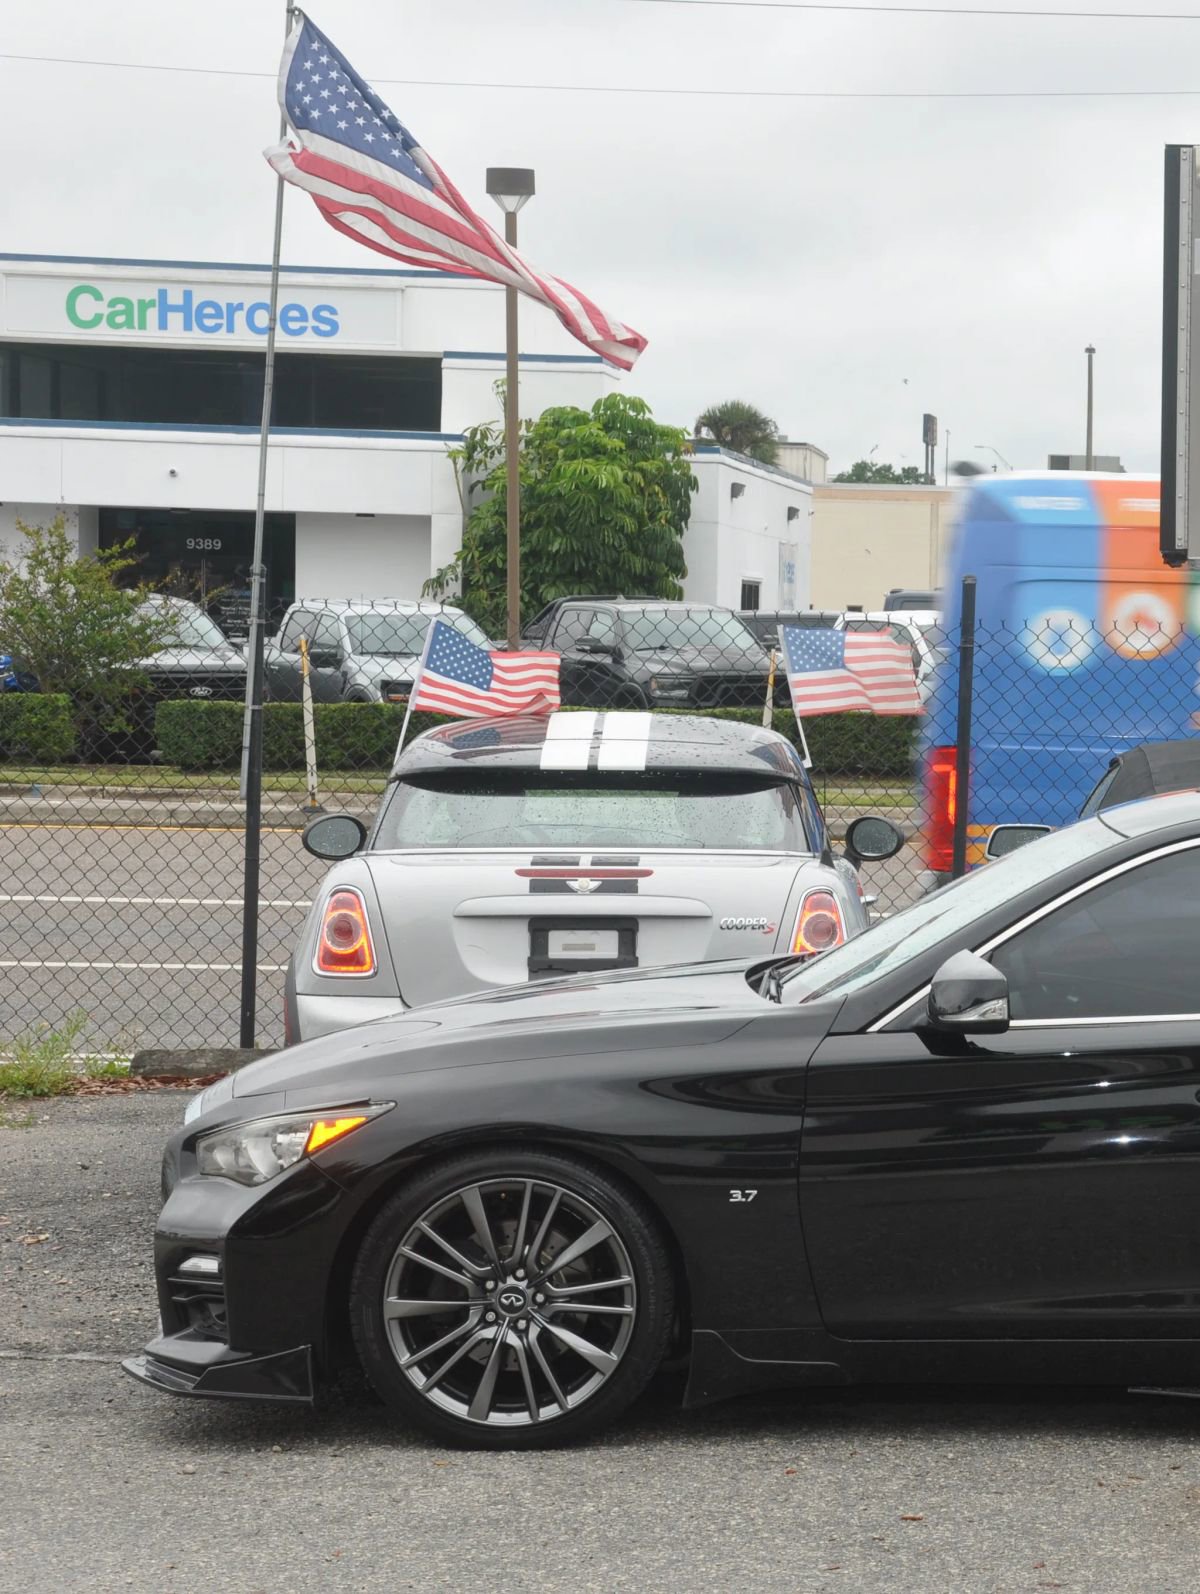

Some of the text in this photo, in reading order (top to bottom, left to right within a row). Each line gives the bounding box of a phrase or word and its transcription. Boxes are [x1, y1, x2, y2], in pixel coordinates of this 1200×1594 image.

[66, 284, 340, 338] CarHeroes
[186, 538, 222, 550] 9389
[719, 917, 768, 931] COOPER
[729, 1190, 758, 1202] 3.7
